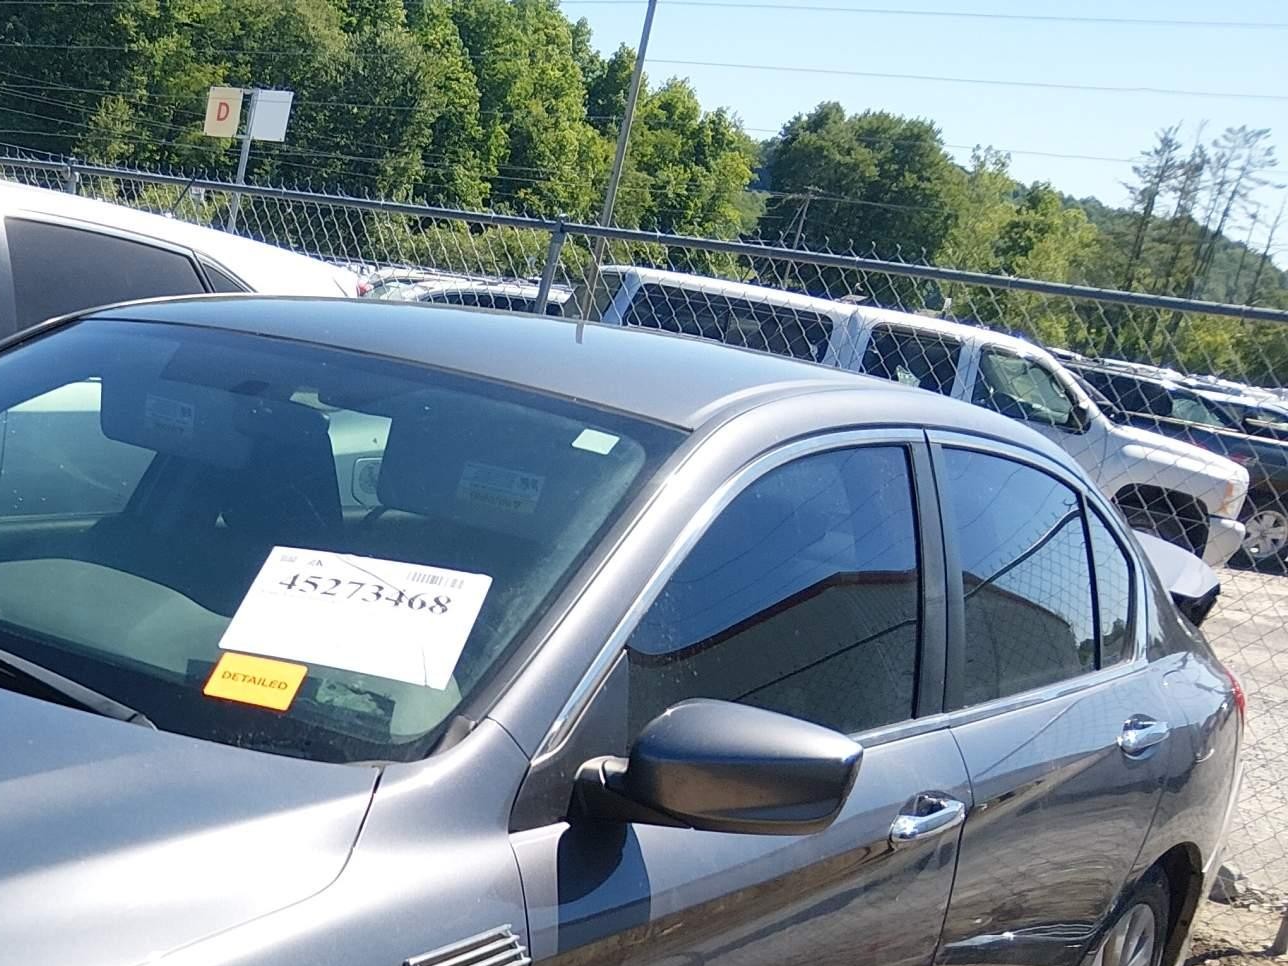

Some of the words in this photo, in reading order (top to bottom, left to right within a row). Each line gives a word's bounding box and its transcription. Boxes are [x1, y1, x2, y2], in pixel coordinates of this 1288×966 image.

[216, 102, 230, 121] D
[278, 573, 452, 615] 45273468
[221, 670, 289, 691] DETAILED
